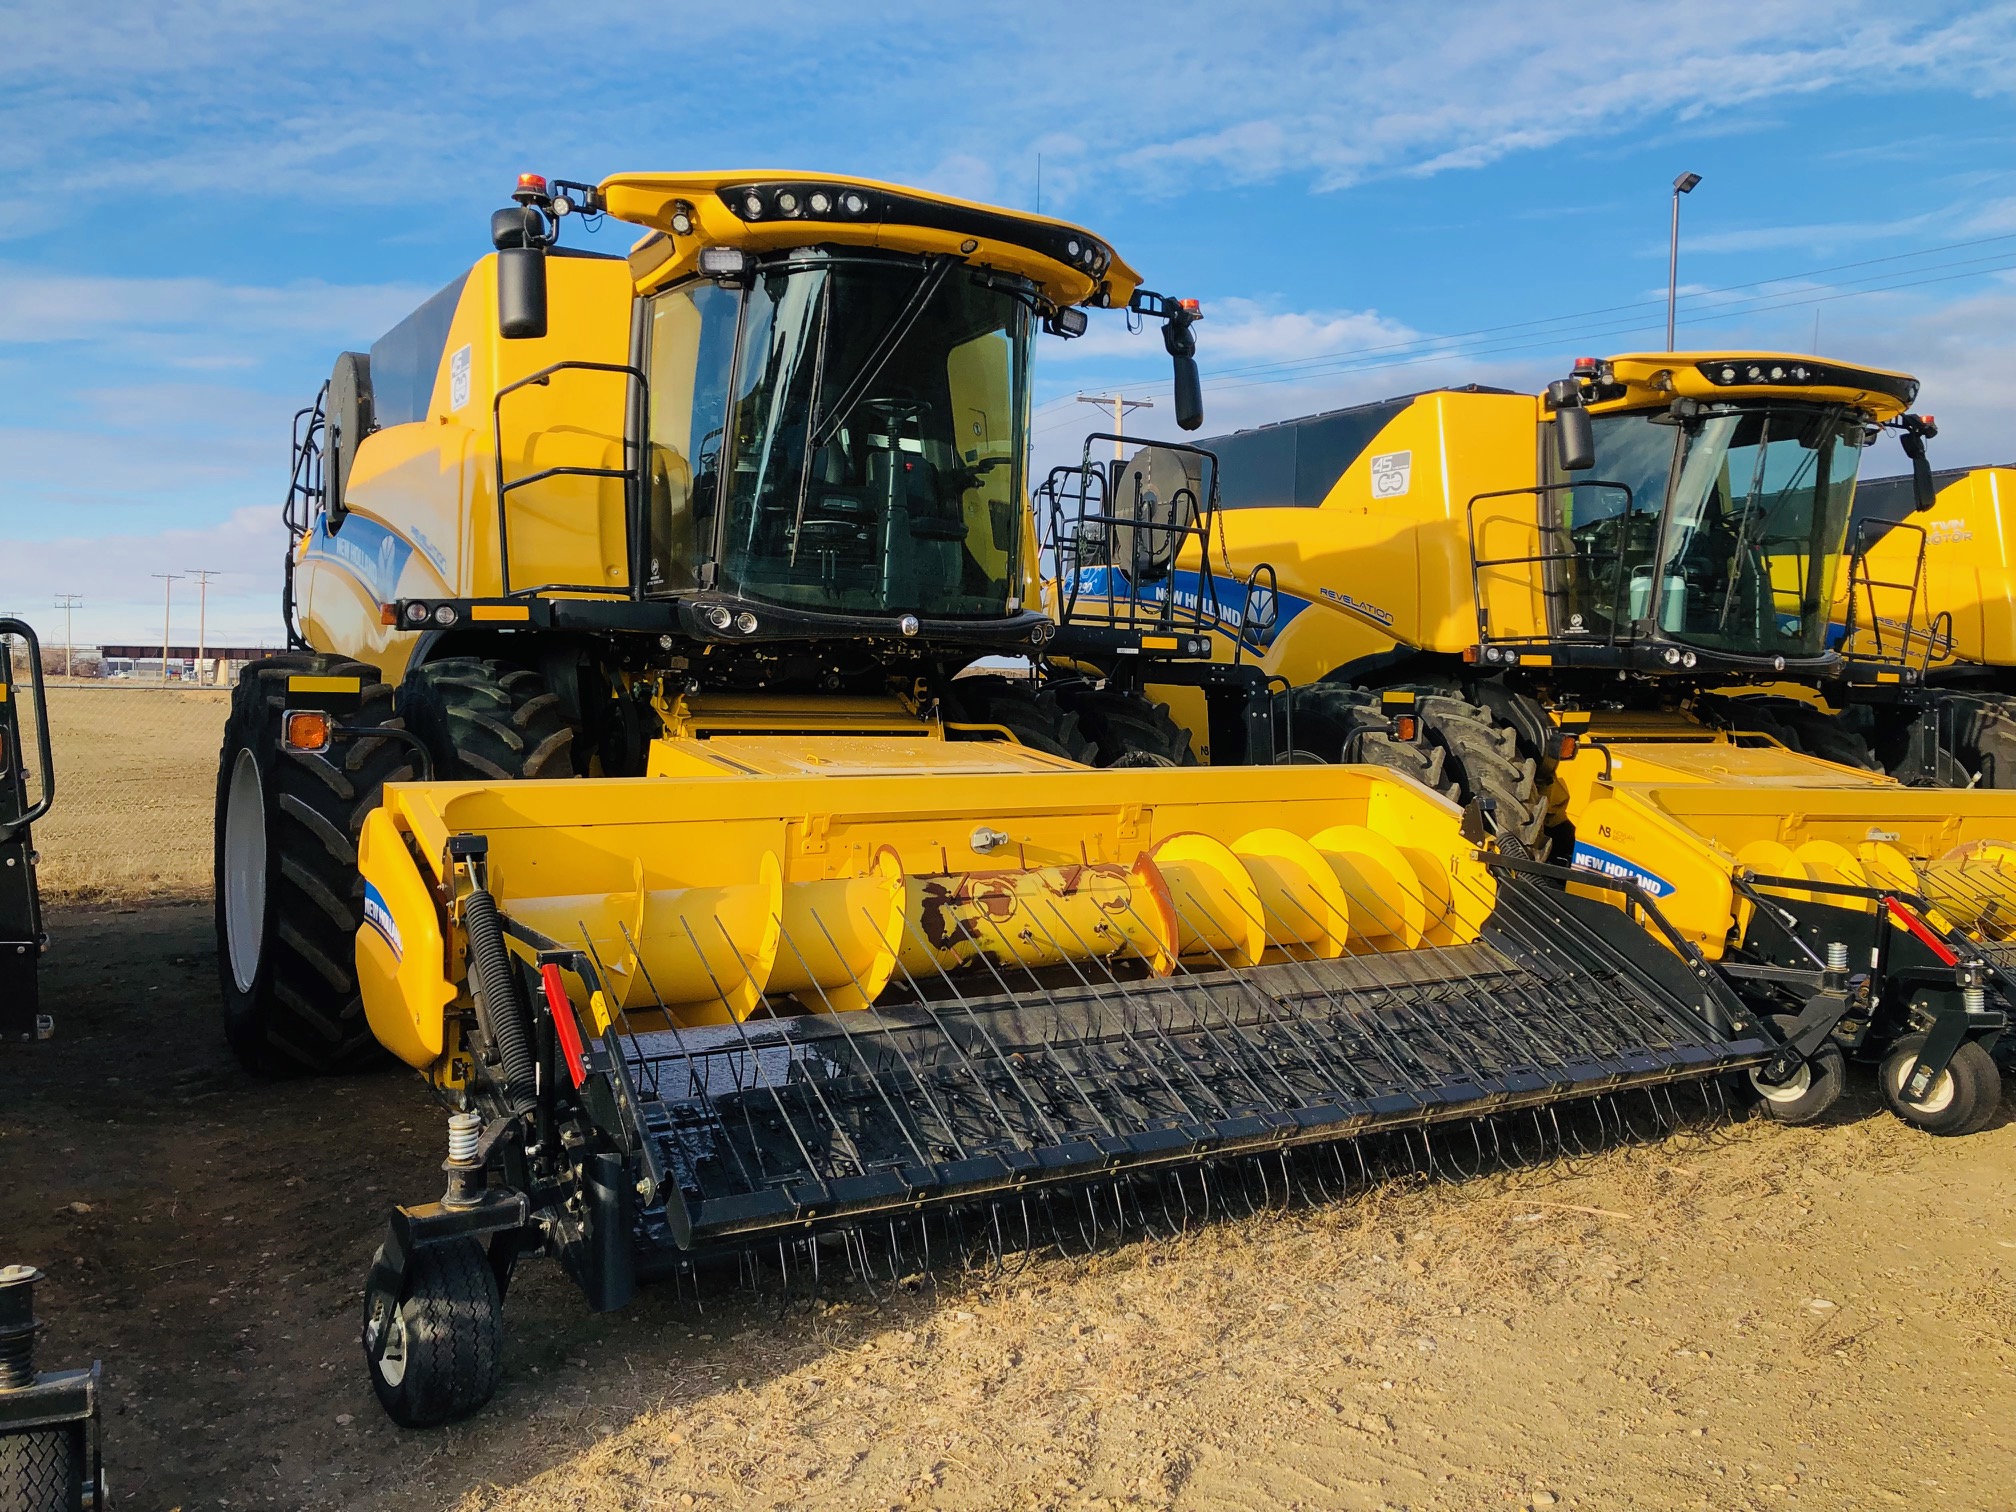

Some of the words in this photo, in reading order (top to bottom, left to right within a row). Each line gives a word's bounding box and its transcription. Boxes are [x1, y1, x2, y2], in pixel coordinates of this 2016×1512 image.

[1373, 455, 1393, 473] 45
[1930, 518, 1965, 531] TWIN
[1319, 587, 1394, 623] REVELATION
[1598, 824, 1611, 838] NB
[1575, 852, 1605, 871] NEW
[364, 896, 379, 921] NEW
